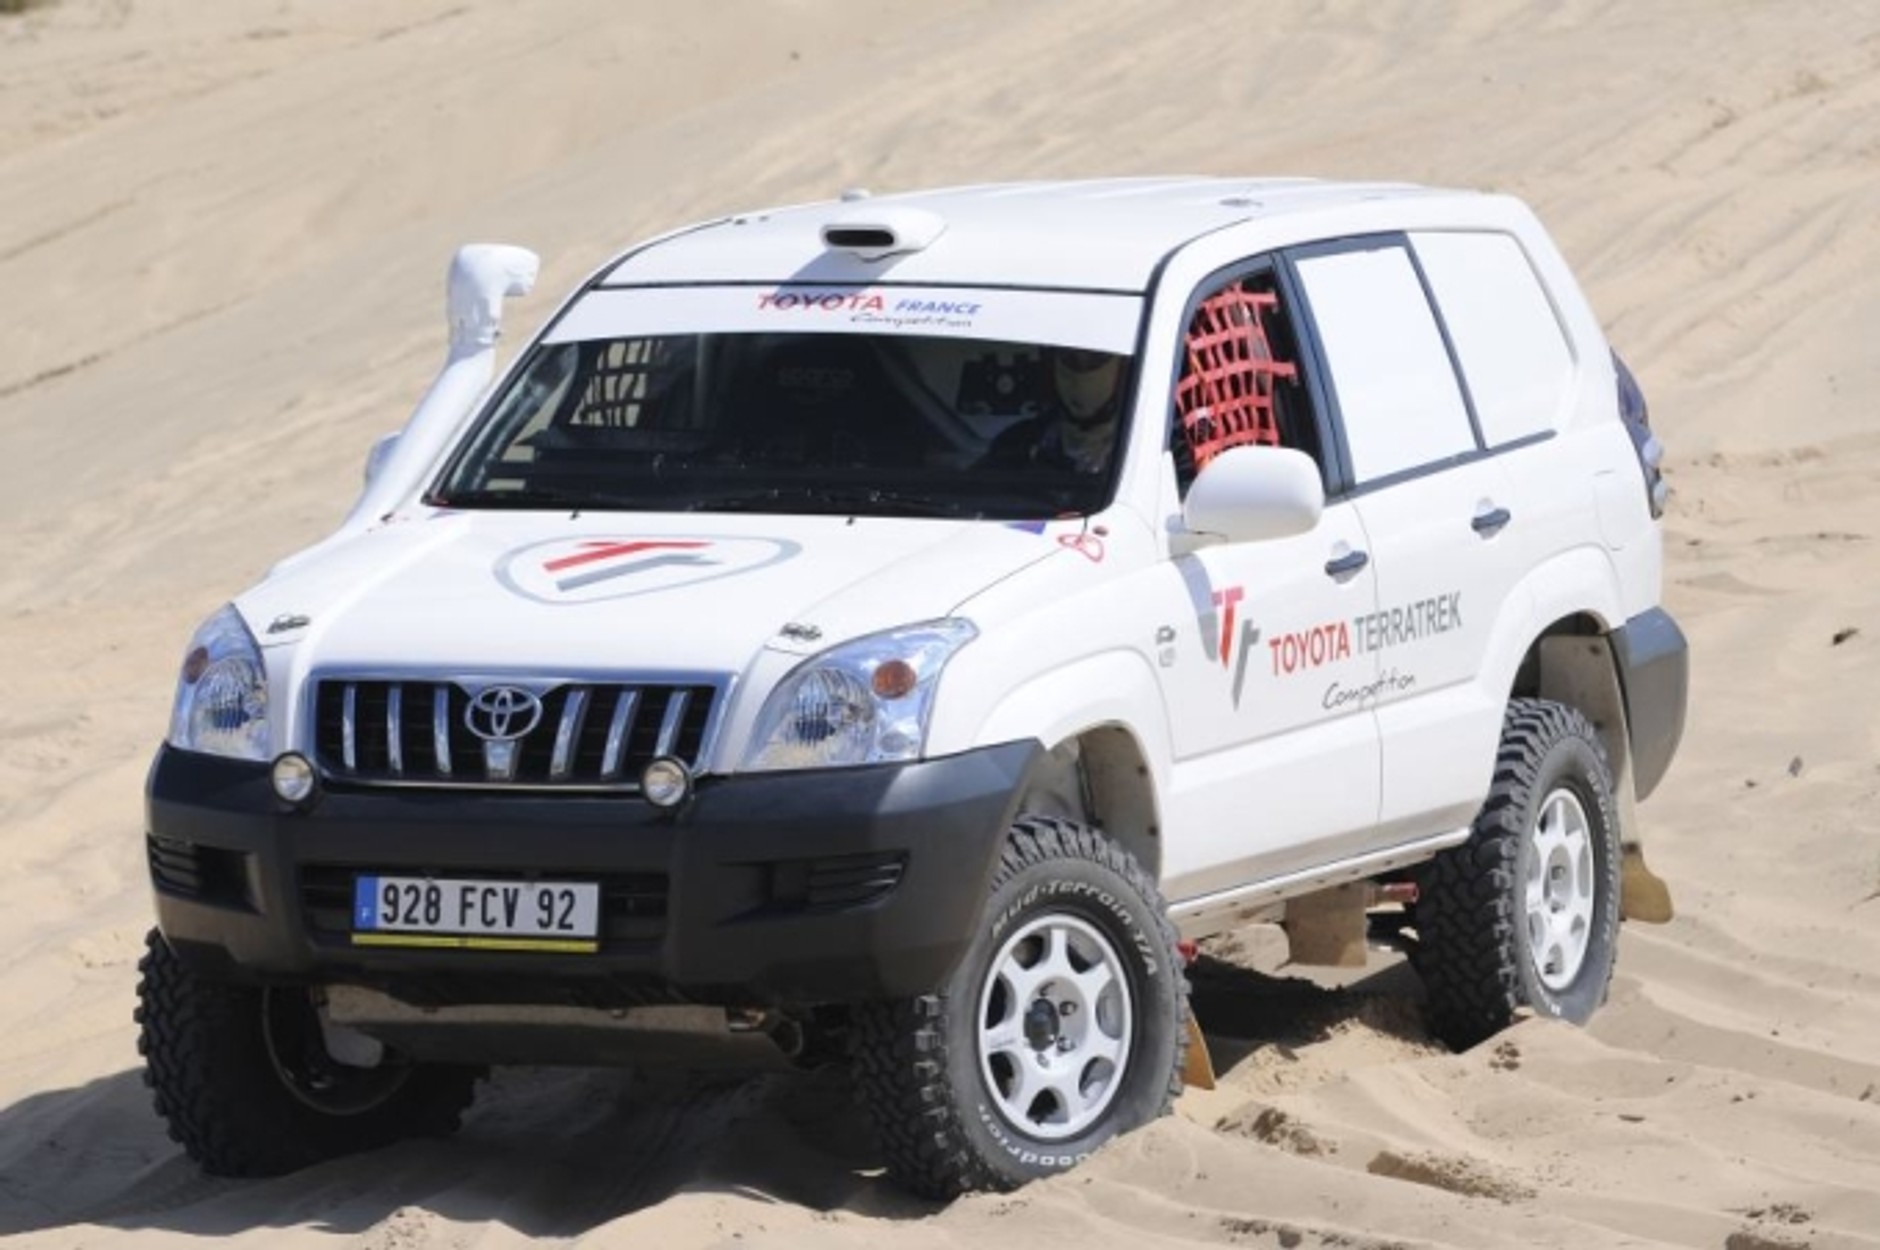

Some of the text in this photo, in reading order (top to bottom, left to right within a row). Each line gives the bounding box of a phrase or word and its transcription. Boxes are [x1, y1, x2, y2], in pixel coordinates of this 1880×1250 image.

[758, 292, 981, 314] TOYOTA FRANCE
[1269, 591, 1462, 676] TOYOTA TERRATREK
[381, 883, 442, 926] 928
[459, 886, 520, 928] FCV
[537, 888, 576, 930] 92
